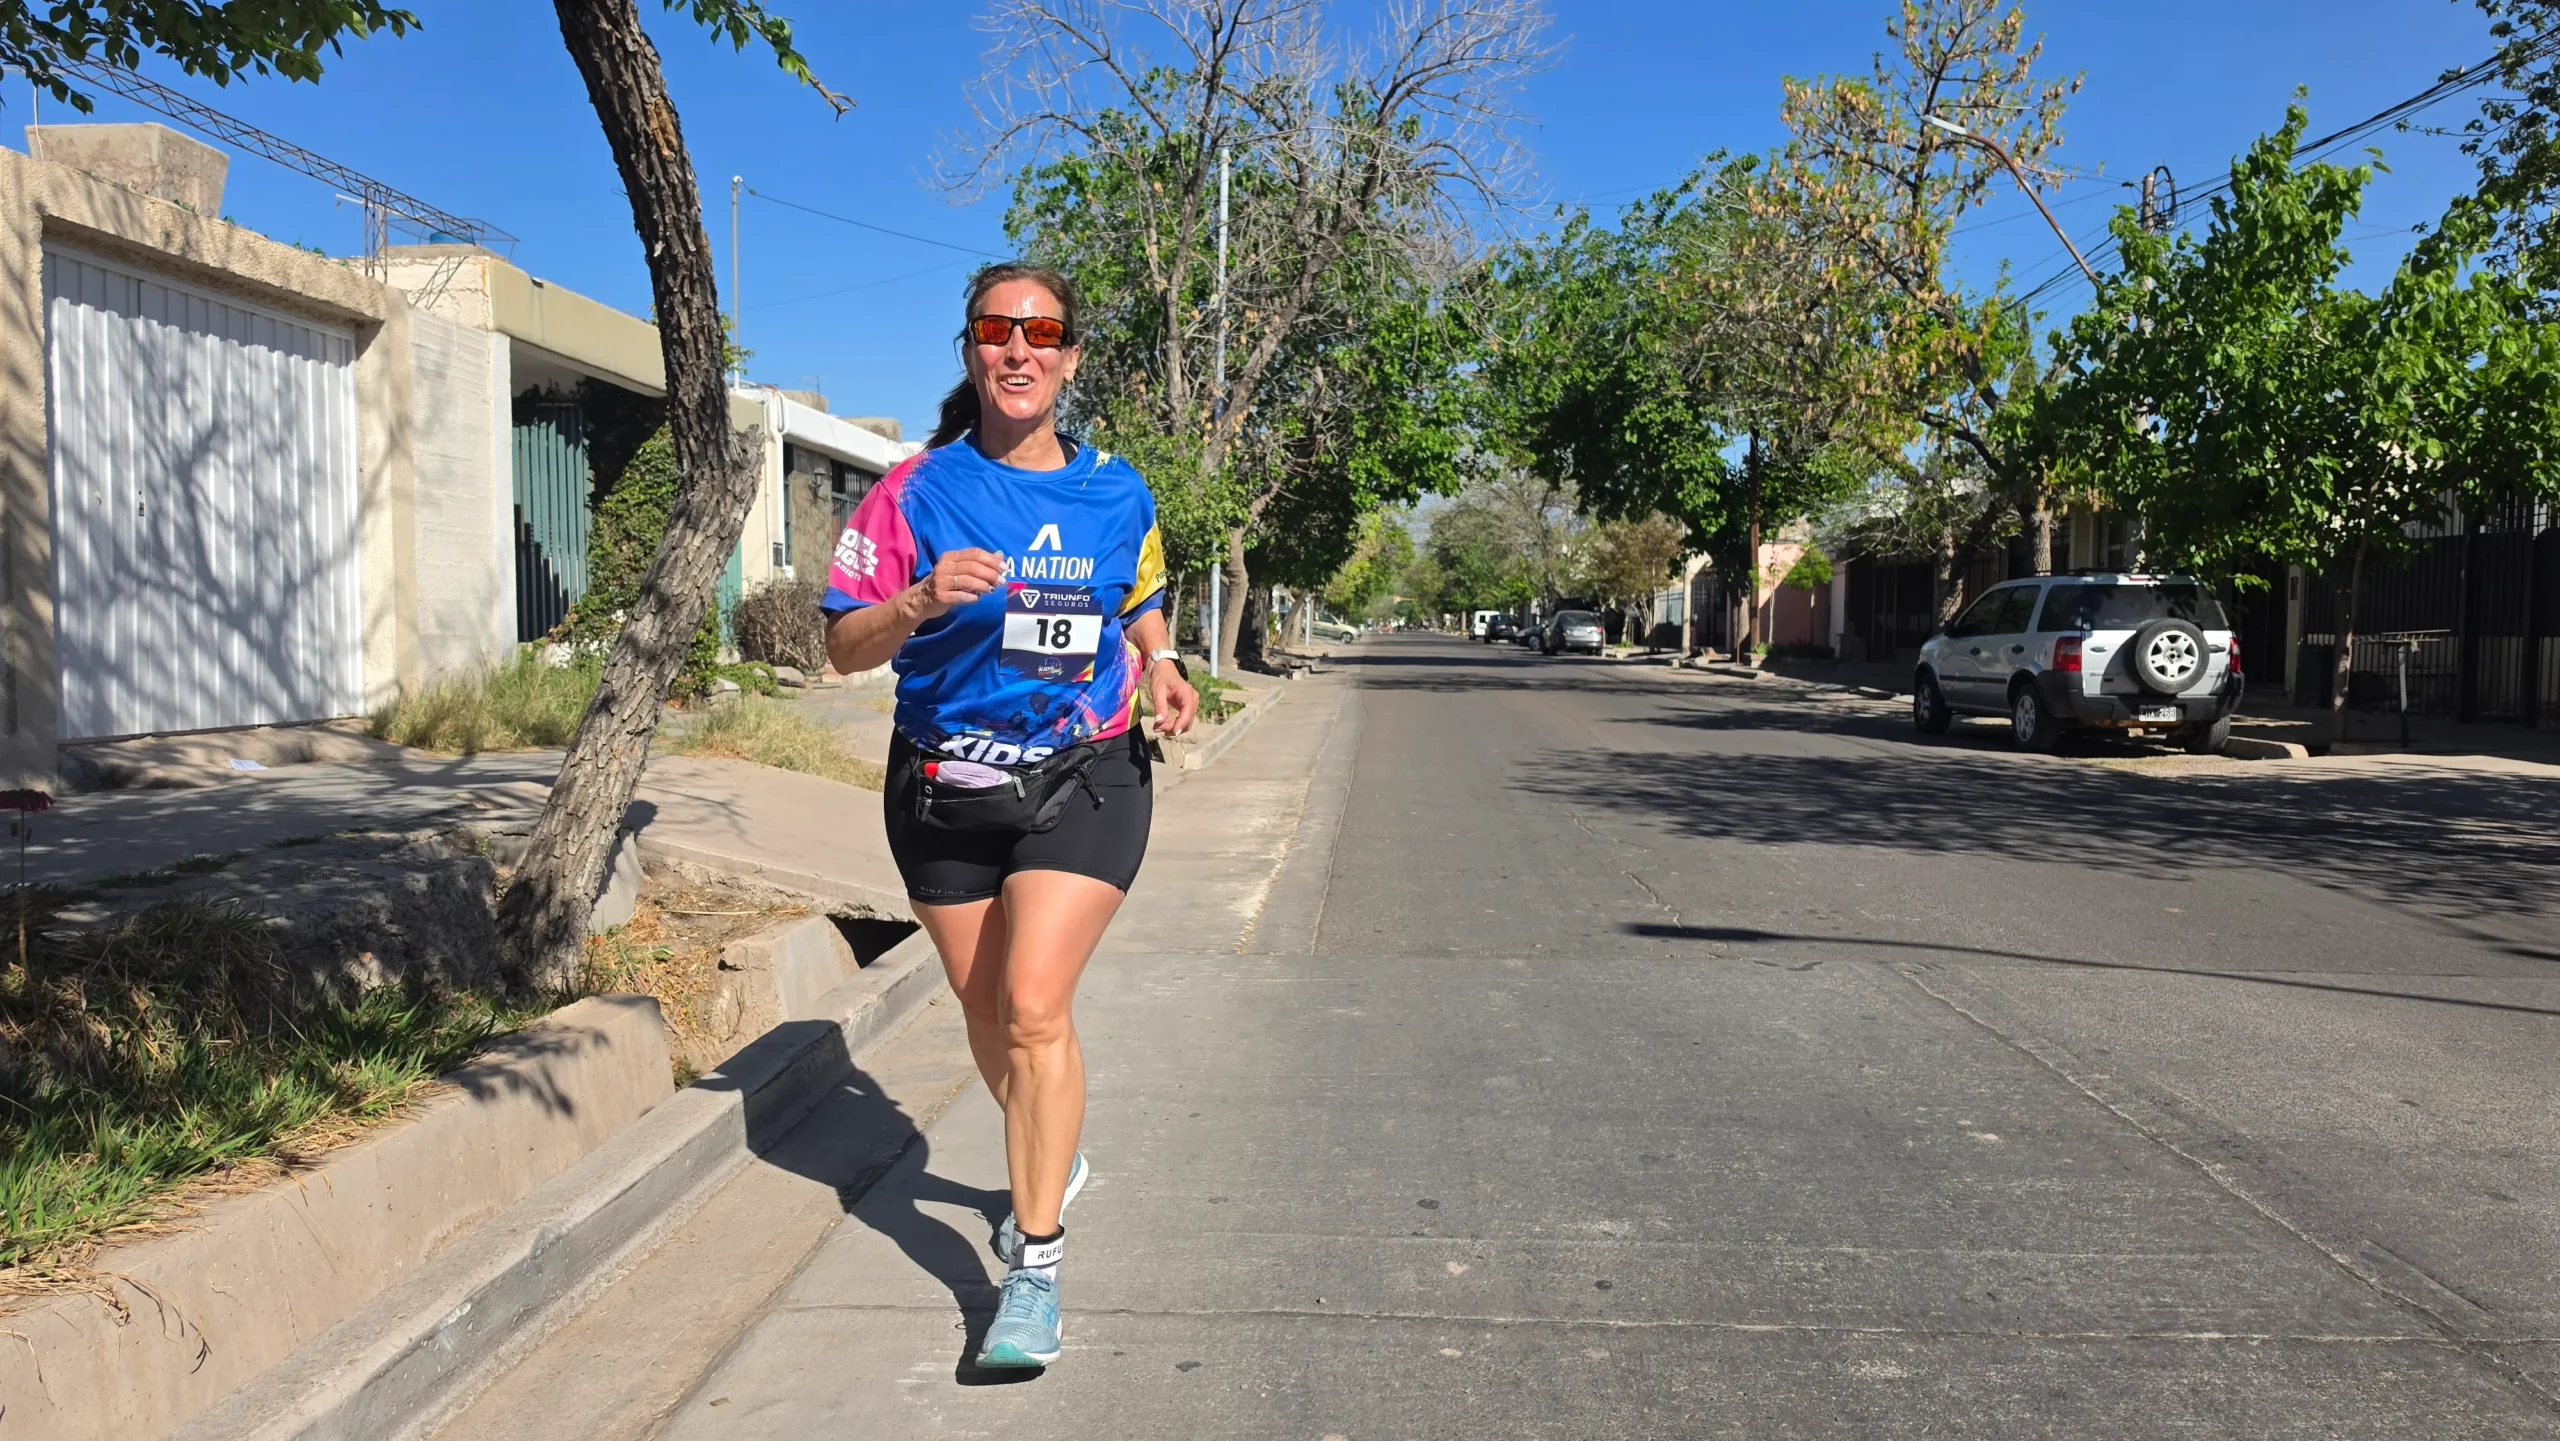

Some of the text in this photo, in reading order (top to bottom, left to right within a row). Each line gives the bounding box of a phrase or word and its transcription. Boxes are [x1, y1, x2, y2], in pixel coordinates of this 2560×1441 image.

[1020, 556, 1095, 580] NATION
[1042, 593, 1091, 602] TRIUNFO
[1044, 600, 1090, 608] SEGUROS
[1036, 618, 1072, 650] 18
[938, 734, 1055, 766] KIDS
[1037, 1243, 1064, 1260] RUFU
